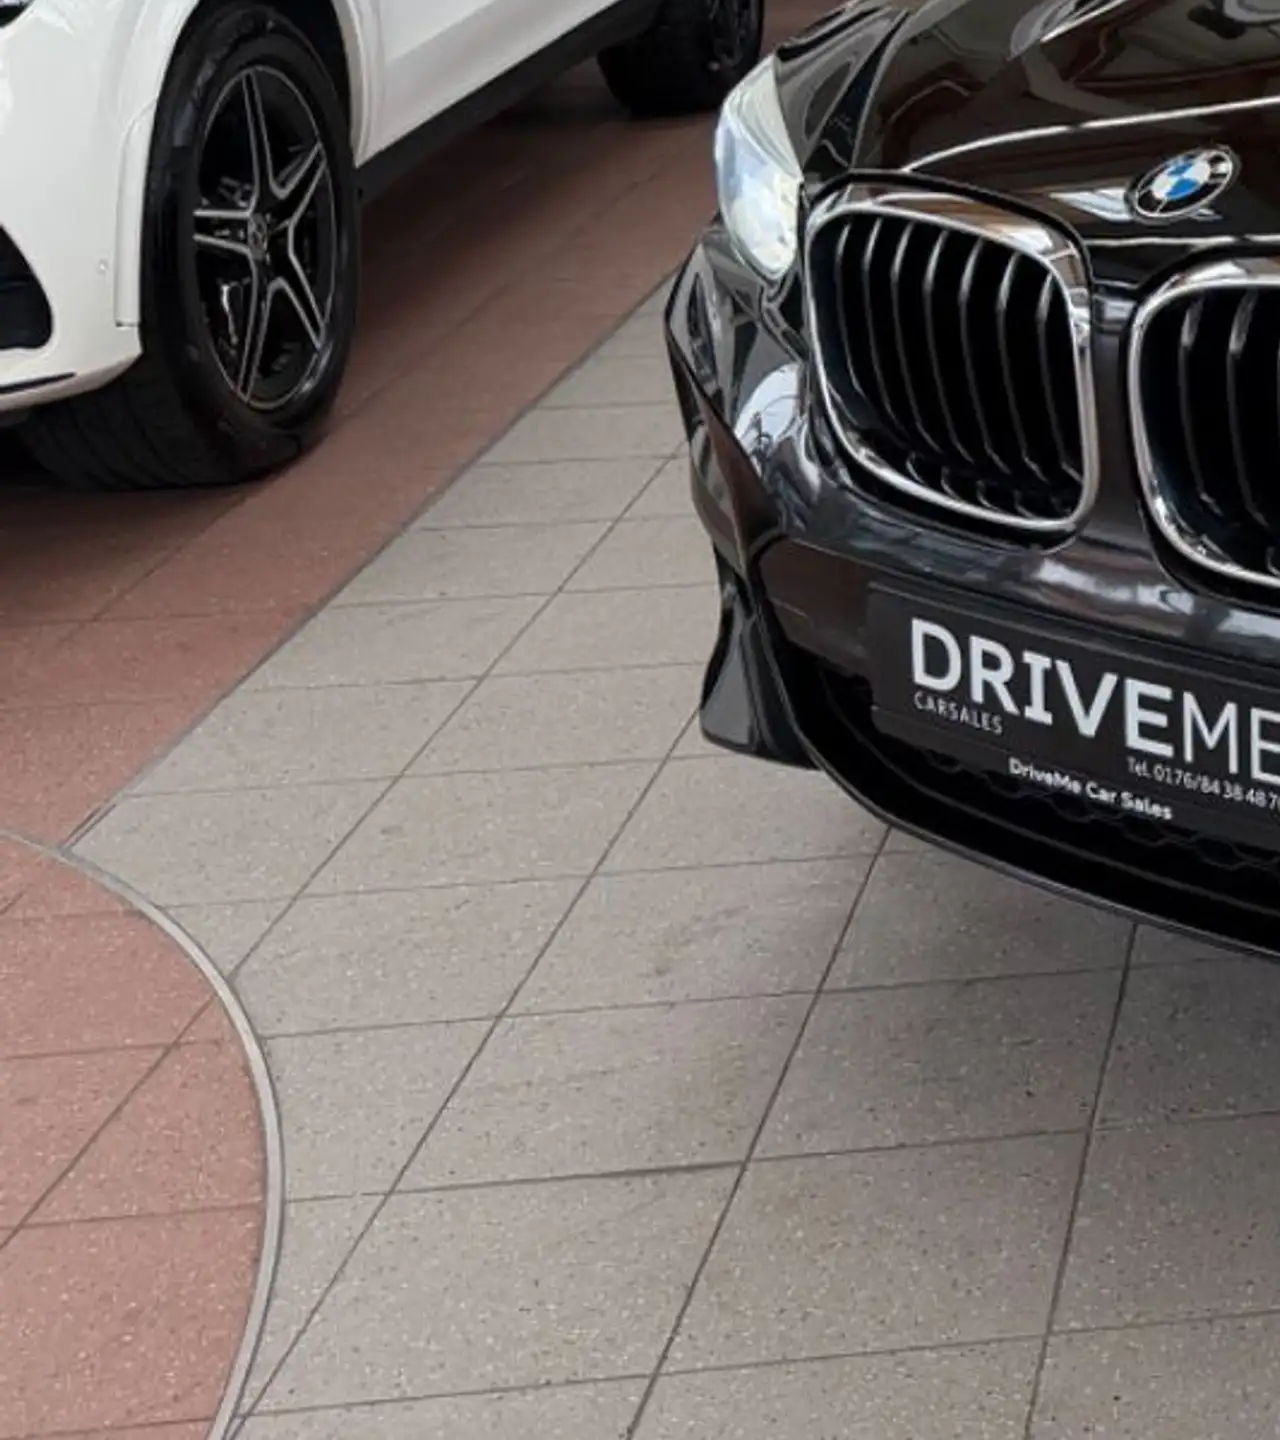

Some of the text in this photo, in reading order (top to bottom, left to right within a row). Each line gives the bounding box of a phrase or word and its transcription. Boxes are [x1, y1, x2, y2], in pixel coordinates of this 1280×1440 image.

[912, 690, 1004, 737] CARSALES
[1008, 757, 1173, 820] DriveMe Car Sales
